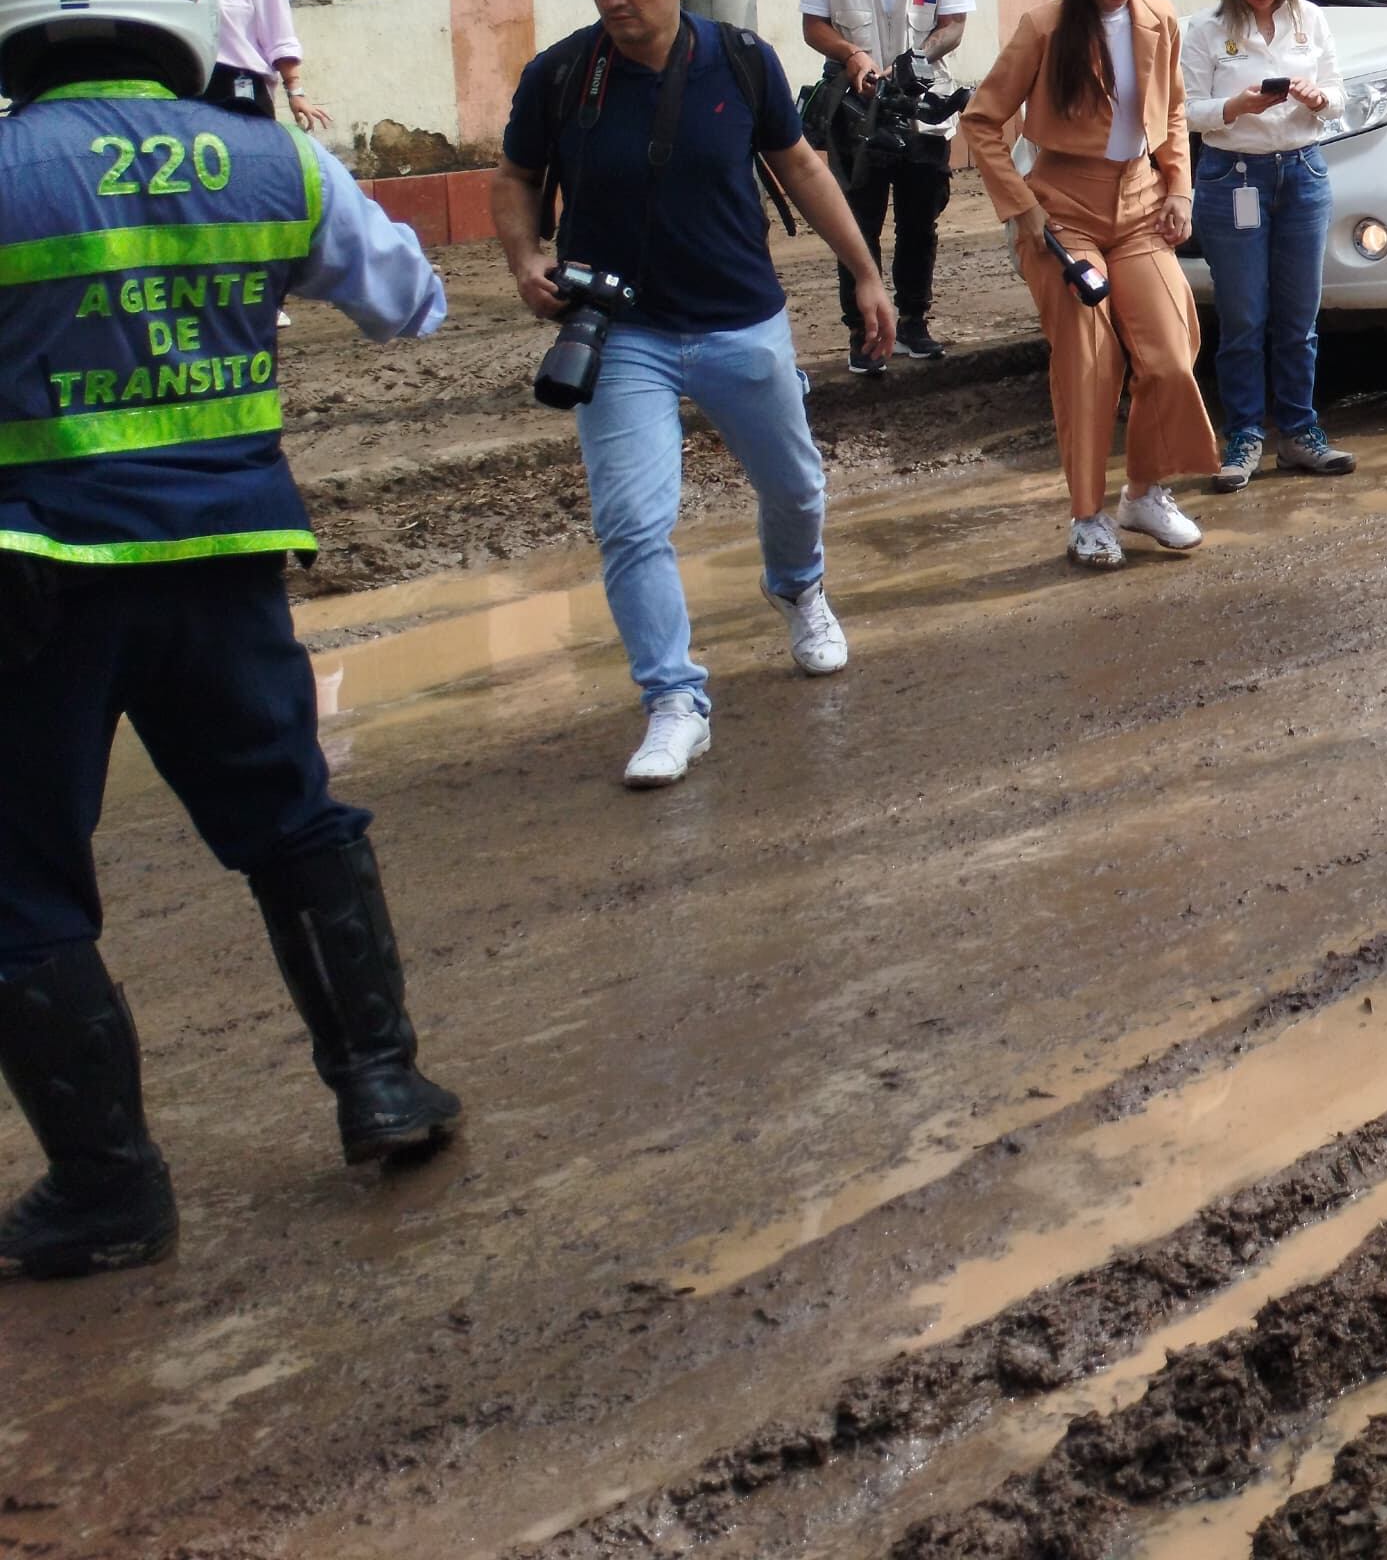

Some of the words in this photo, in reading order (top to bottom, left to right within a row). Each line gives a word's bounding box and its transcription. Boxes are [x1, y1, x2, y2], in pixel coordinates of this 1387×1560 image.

[590, 56, 607, 95] Canon
[91, 132, 231, 196] 220
[76, 271, 268, 318] AGENTE
[148, 317, 200, 356] DE
[50, 351, 272, 408] TRANSITO
